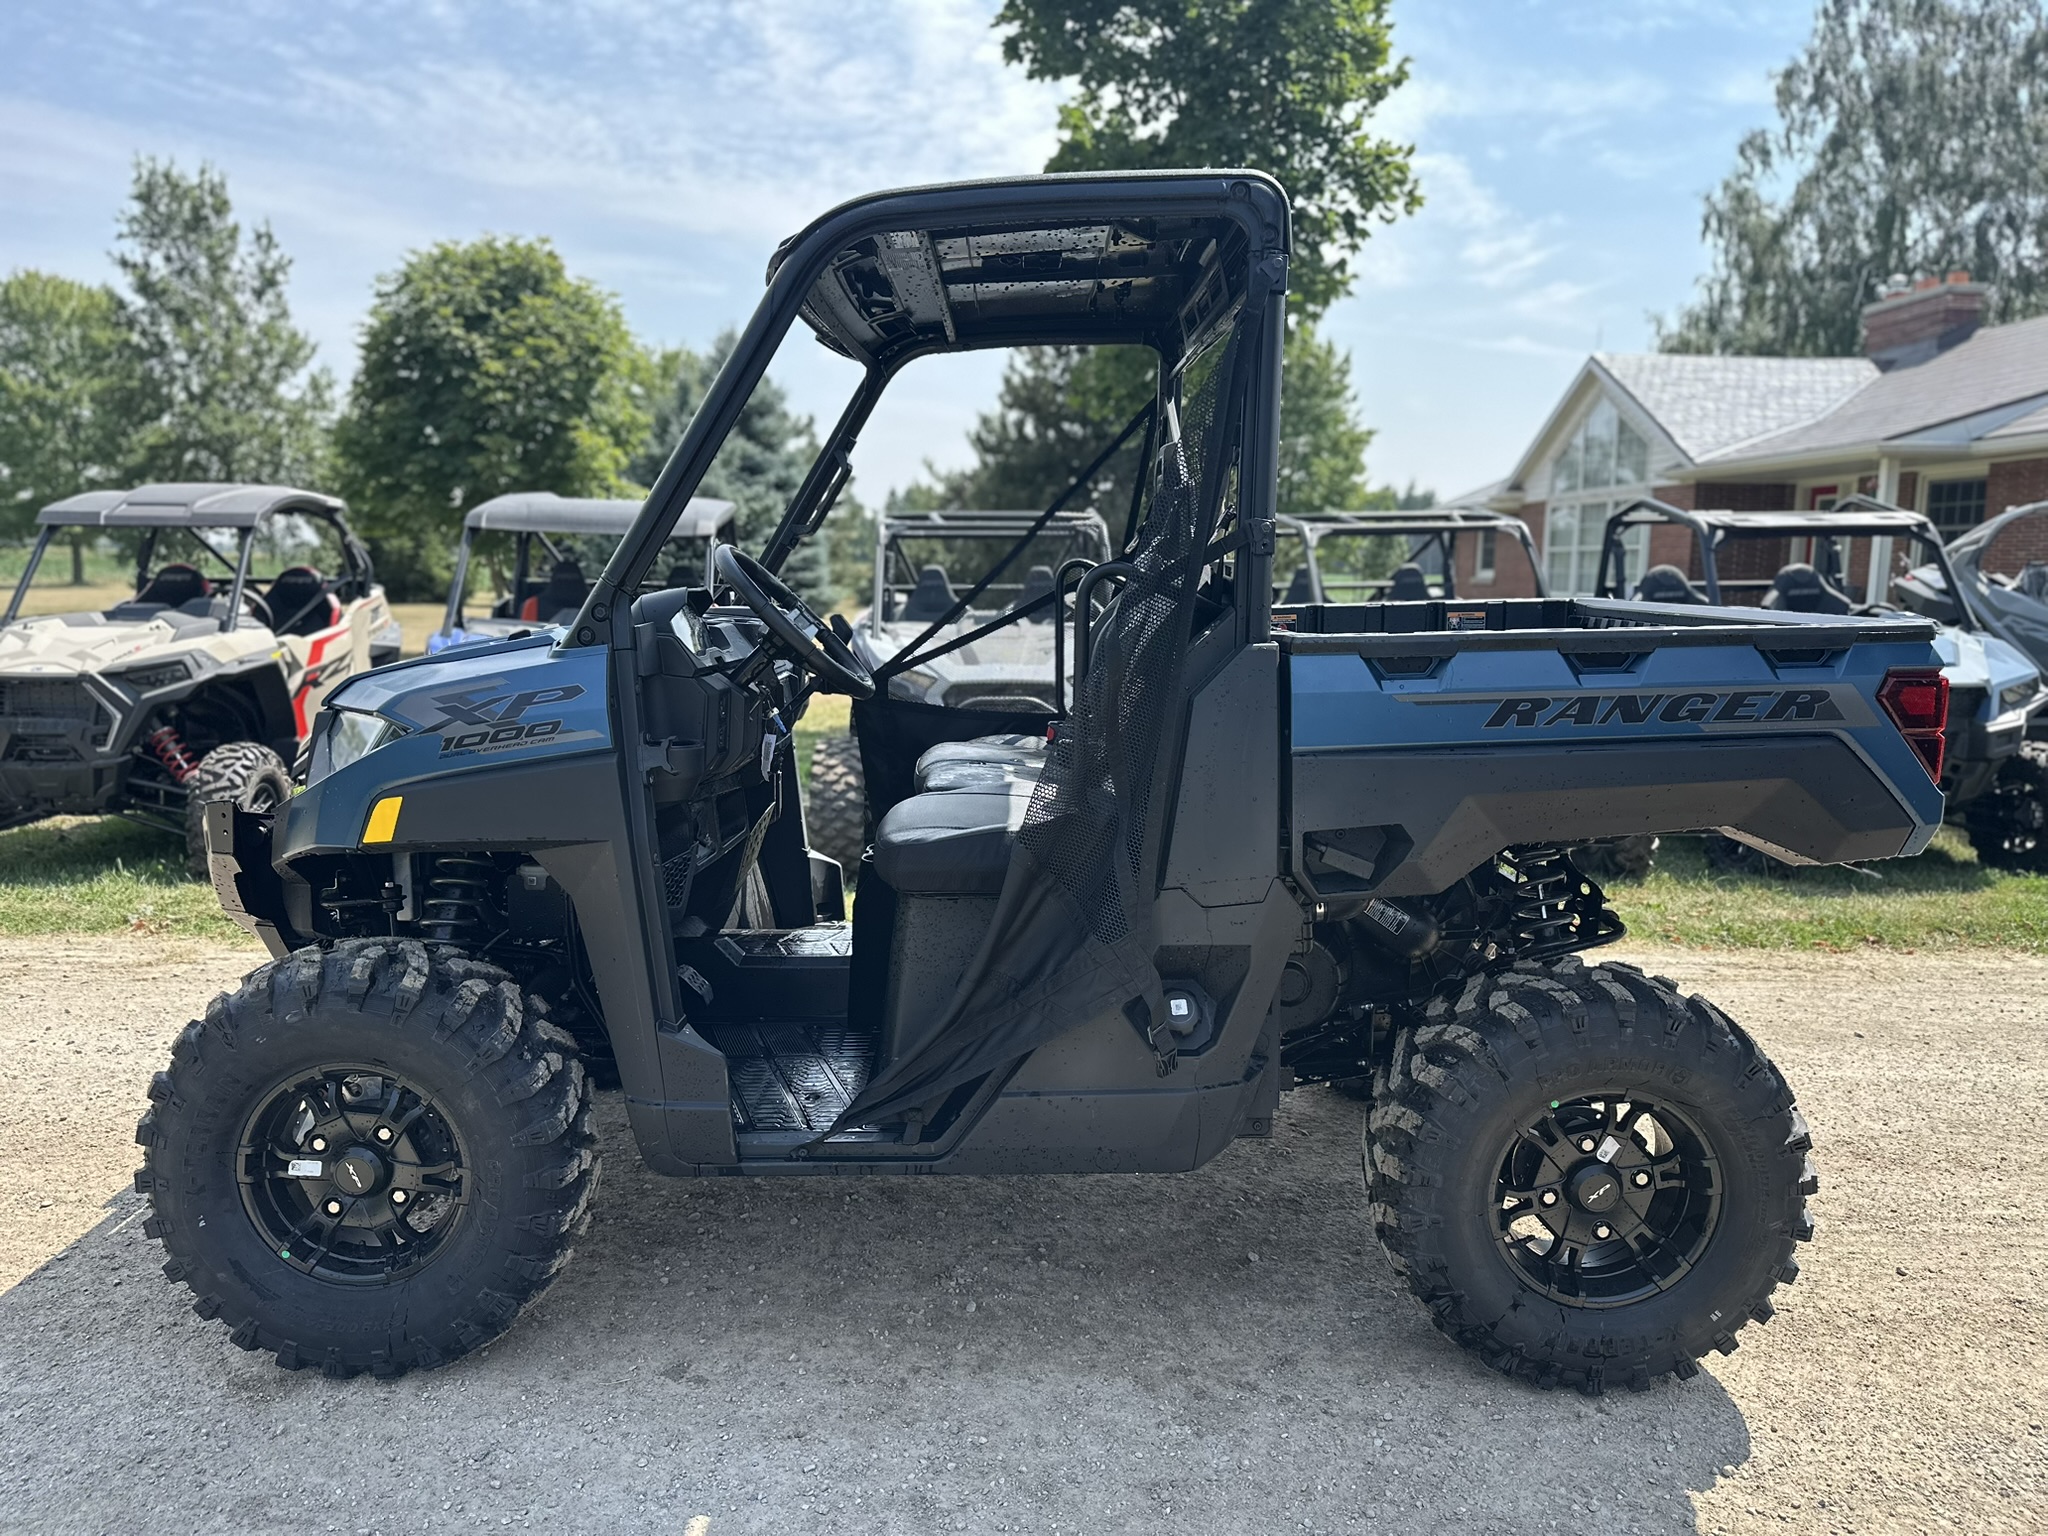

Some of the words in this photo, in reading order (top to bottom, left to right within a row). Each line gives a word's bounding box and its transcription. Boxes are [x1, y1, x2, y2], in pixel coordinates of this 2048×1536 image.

[416, 682, 588, 737] XP
[1482, 688, 1832, 729] RANGER
[438, 748, 467, 760] DUAL
[468, 740, 529, 754] OVERHEAD
[529, 736, 556, 746] CAM
[440, 719, 563, 754] 1000
[344, 1161, 362, 1188] XP
[1587, 1183, 1611, 1204] XP
